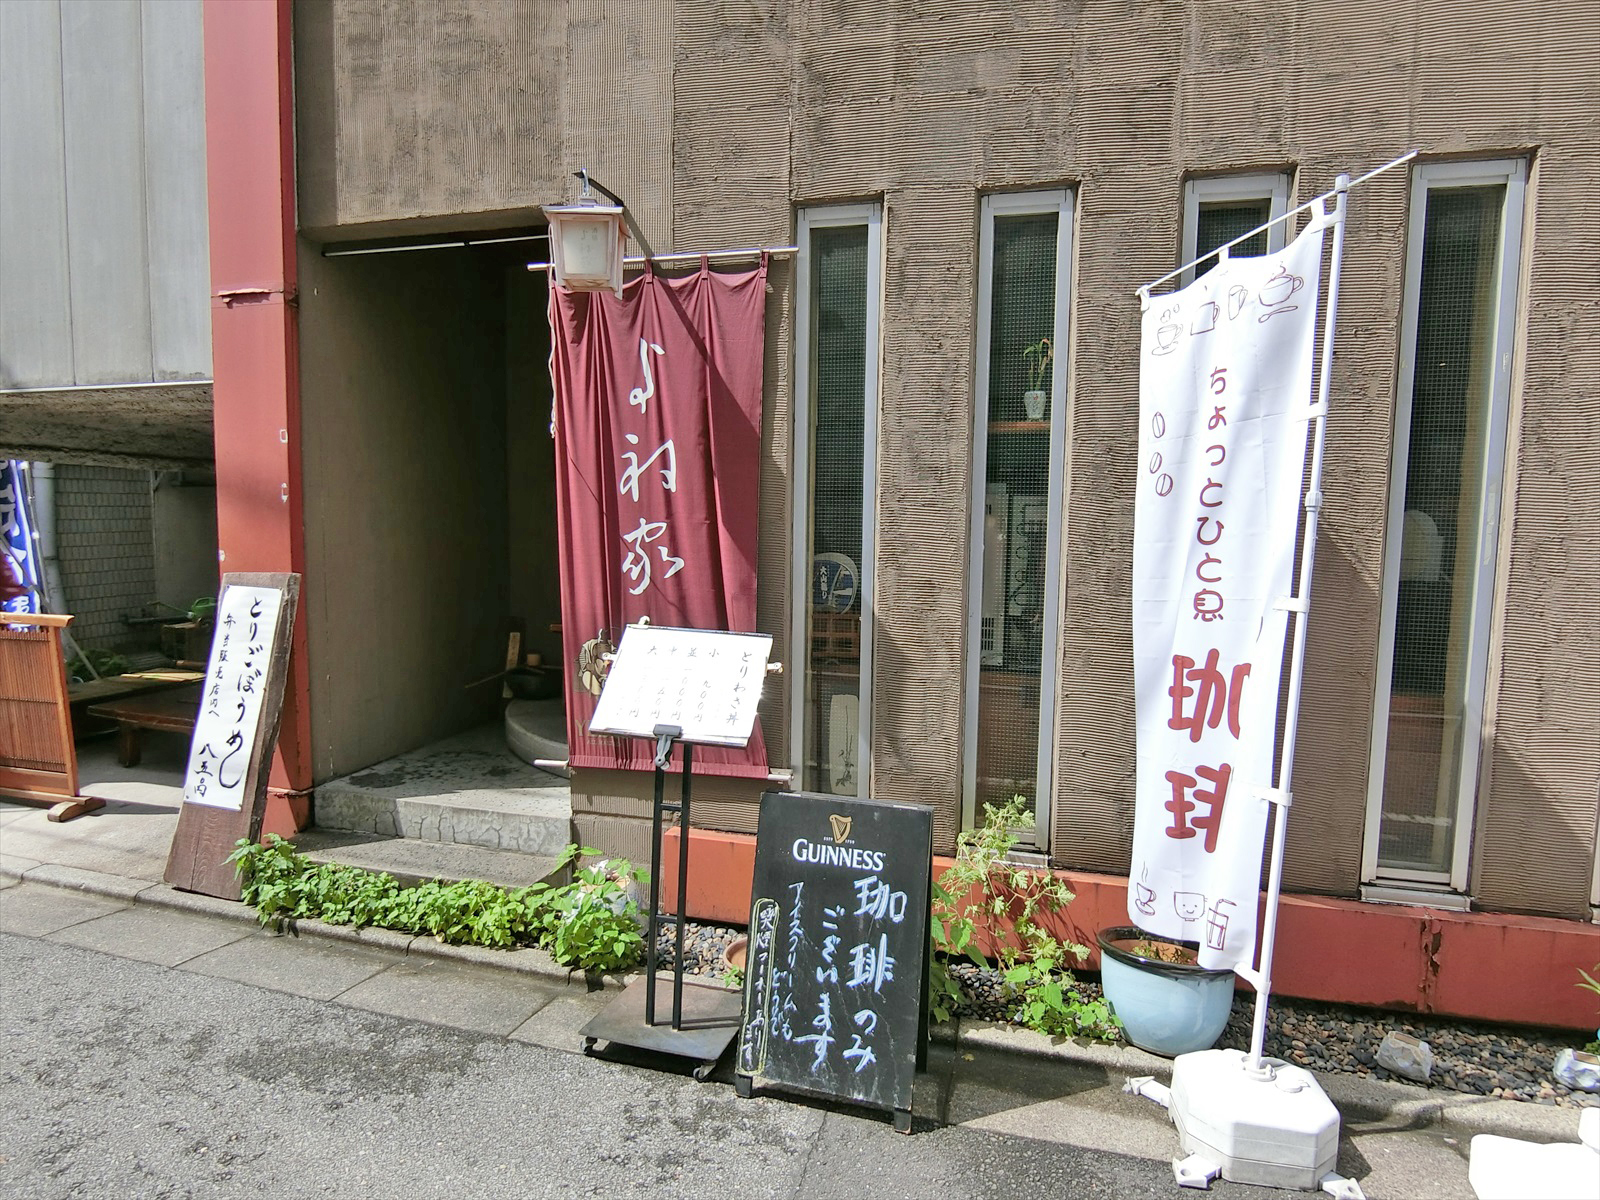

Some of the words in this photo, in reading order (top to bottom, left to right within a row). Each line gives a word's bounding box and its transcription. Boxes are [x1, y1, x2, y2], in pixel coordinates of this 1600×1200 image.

[1193, 366, 1228, 622] ちょっとひと息
[218, 596, 264, 789] とりごぼうめし
[792, 838, 884, 872] GUINNESS
[793, 905, 846, 1073] ございます
